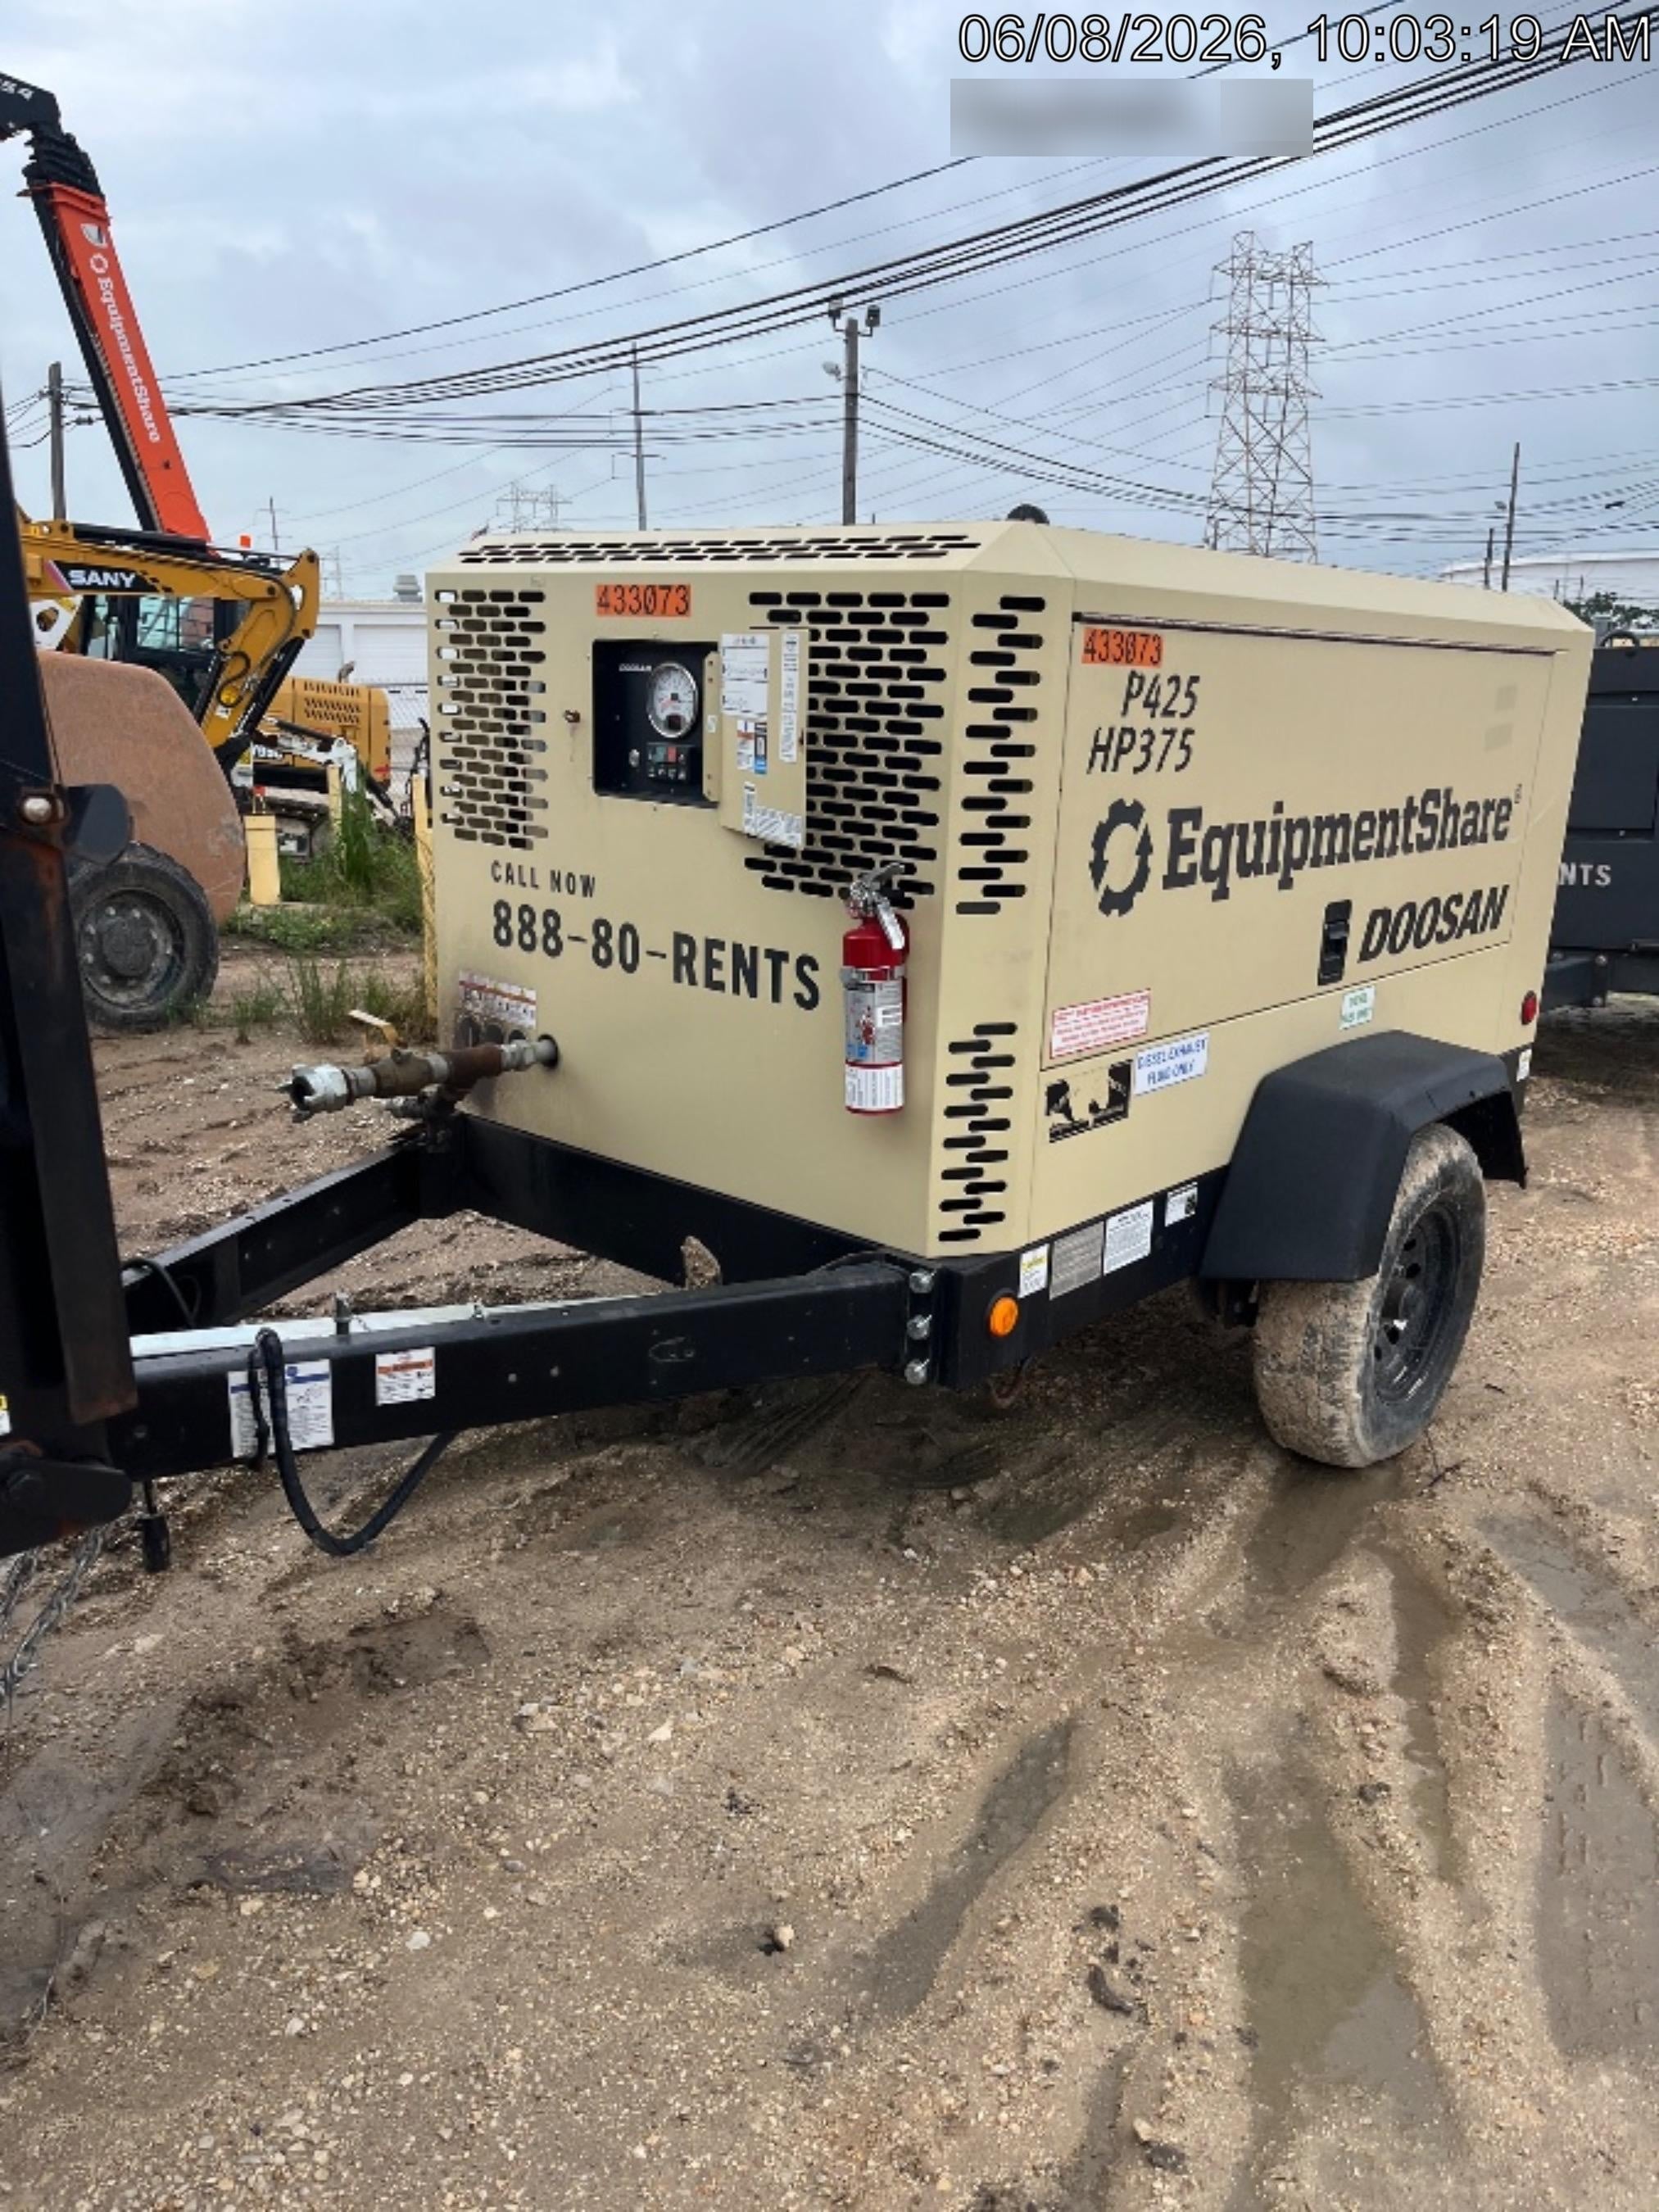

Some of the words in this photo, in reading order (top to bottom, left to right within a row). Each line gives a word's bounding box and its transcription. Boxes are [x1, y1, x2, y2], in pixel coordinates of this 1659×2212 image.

[97, 277, 161, 443] EquipmentShare
[68, 569, 135, 588] SANY
[596, 584, 691, 615] 433073
[1084, 629, 1163, 665] 433073
[1120, 669, 1200, 719] P425
[1086, 726, 1196, 775] HP375
[1162, 786, 1513, 902] EquipmentShare
[491, 859, 540, 889] CALL
[550, 869, 596, 898] NOW
[1357, 884, 1511, 963] DOOSAN
[492, 900, 820, 1012] 888-80-RENTS
